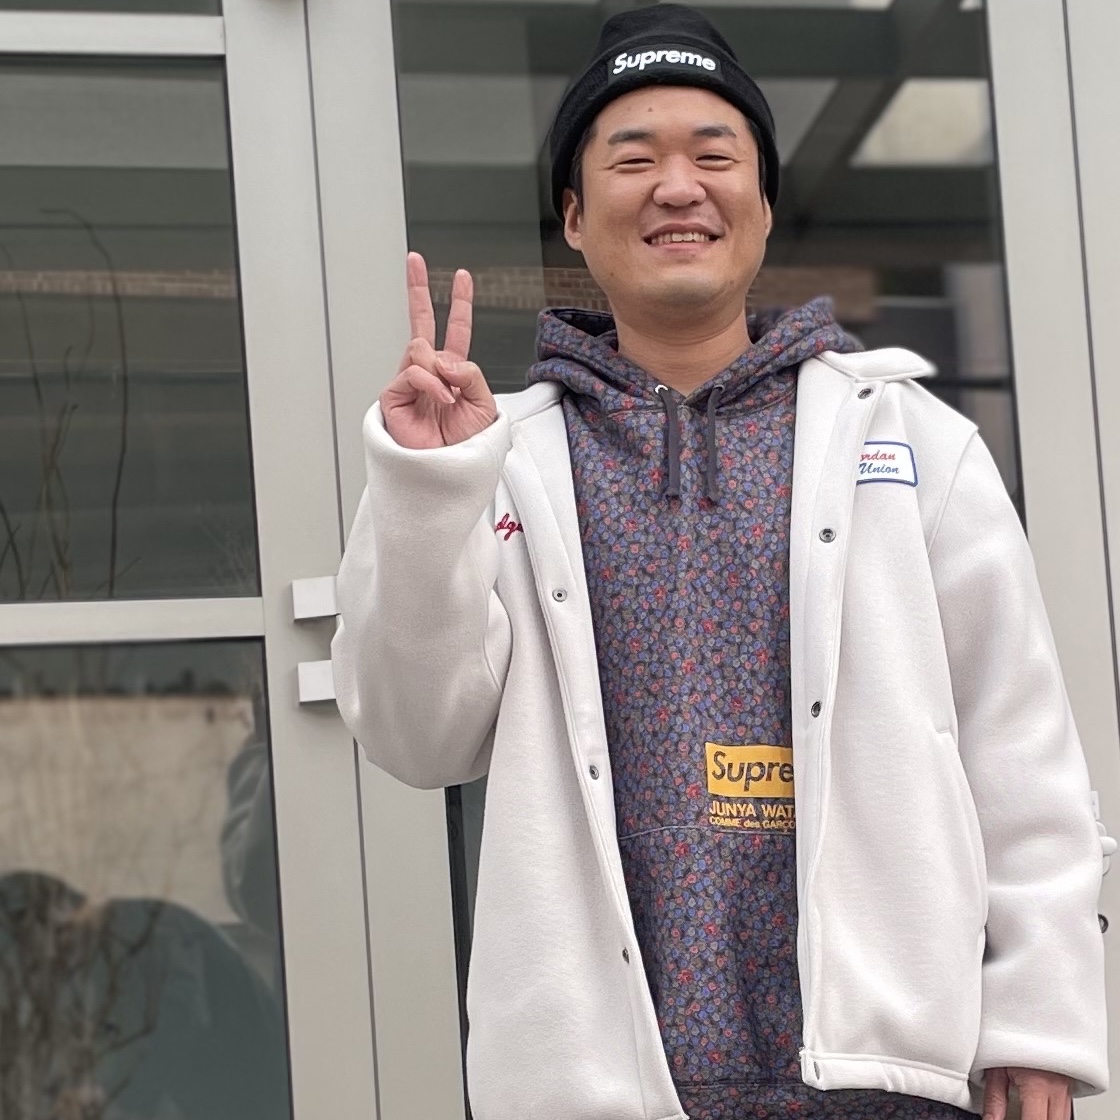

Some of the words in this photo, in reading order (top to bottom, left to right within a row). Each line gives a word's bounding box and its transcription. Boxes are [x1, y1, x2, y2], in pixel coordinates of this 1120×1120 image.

[612, 50, 716, 75] Supreme
[859, 462, 900, 475] Union
[712, 751, 794, 792] Supre
[709, 800, 757, 817] JUNYA
[709, 816, 742, 828] COMME
[743, 819, 760, 829] des
